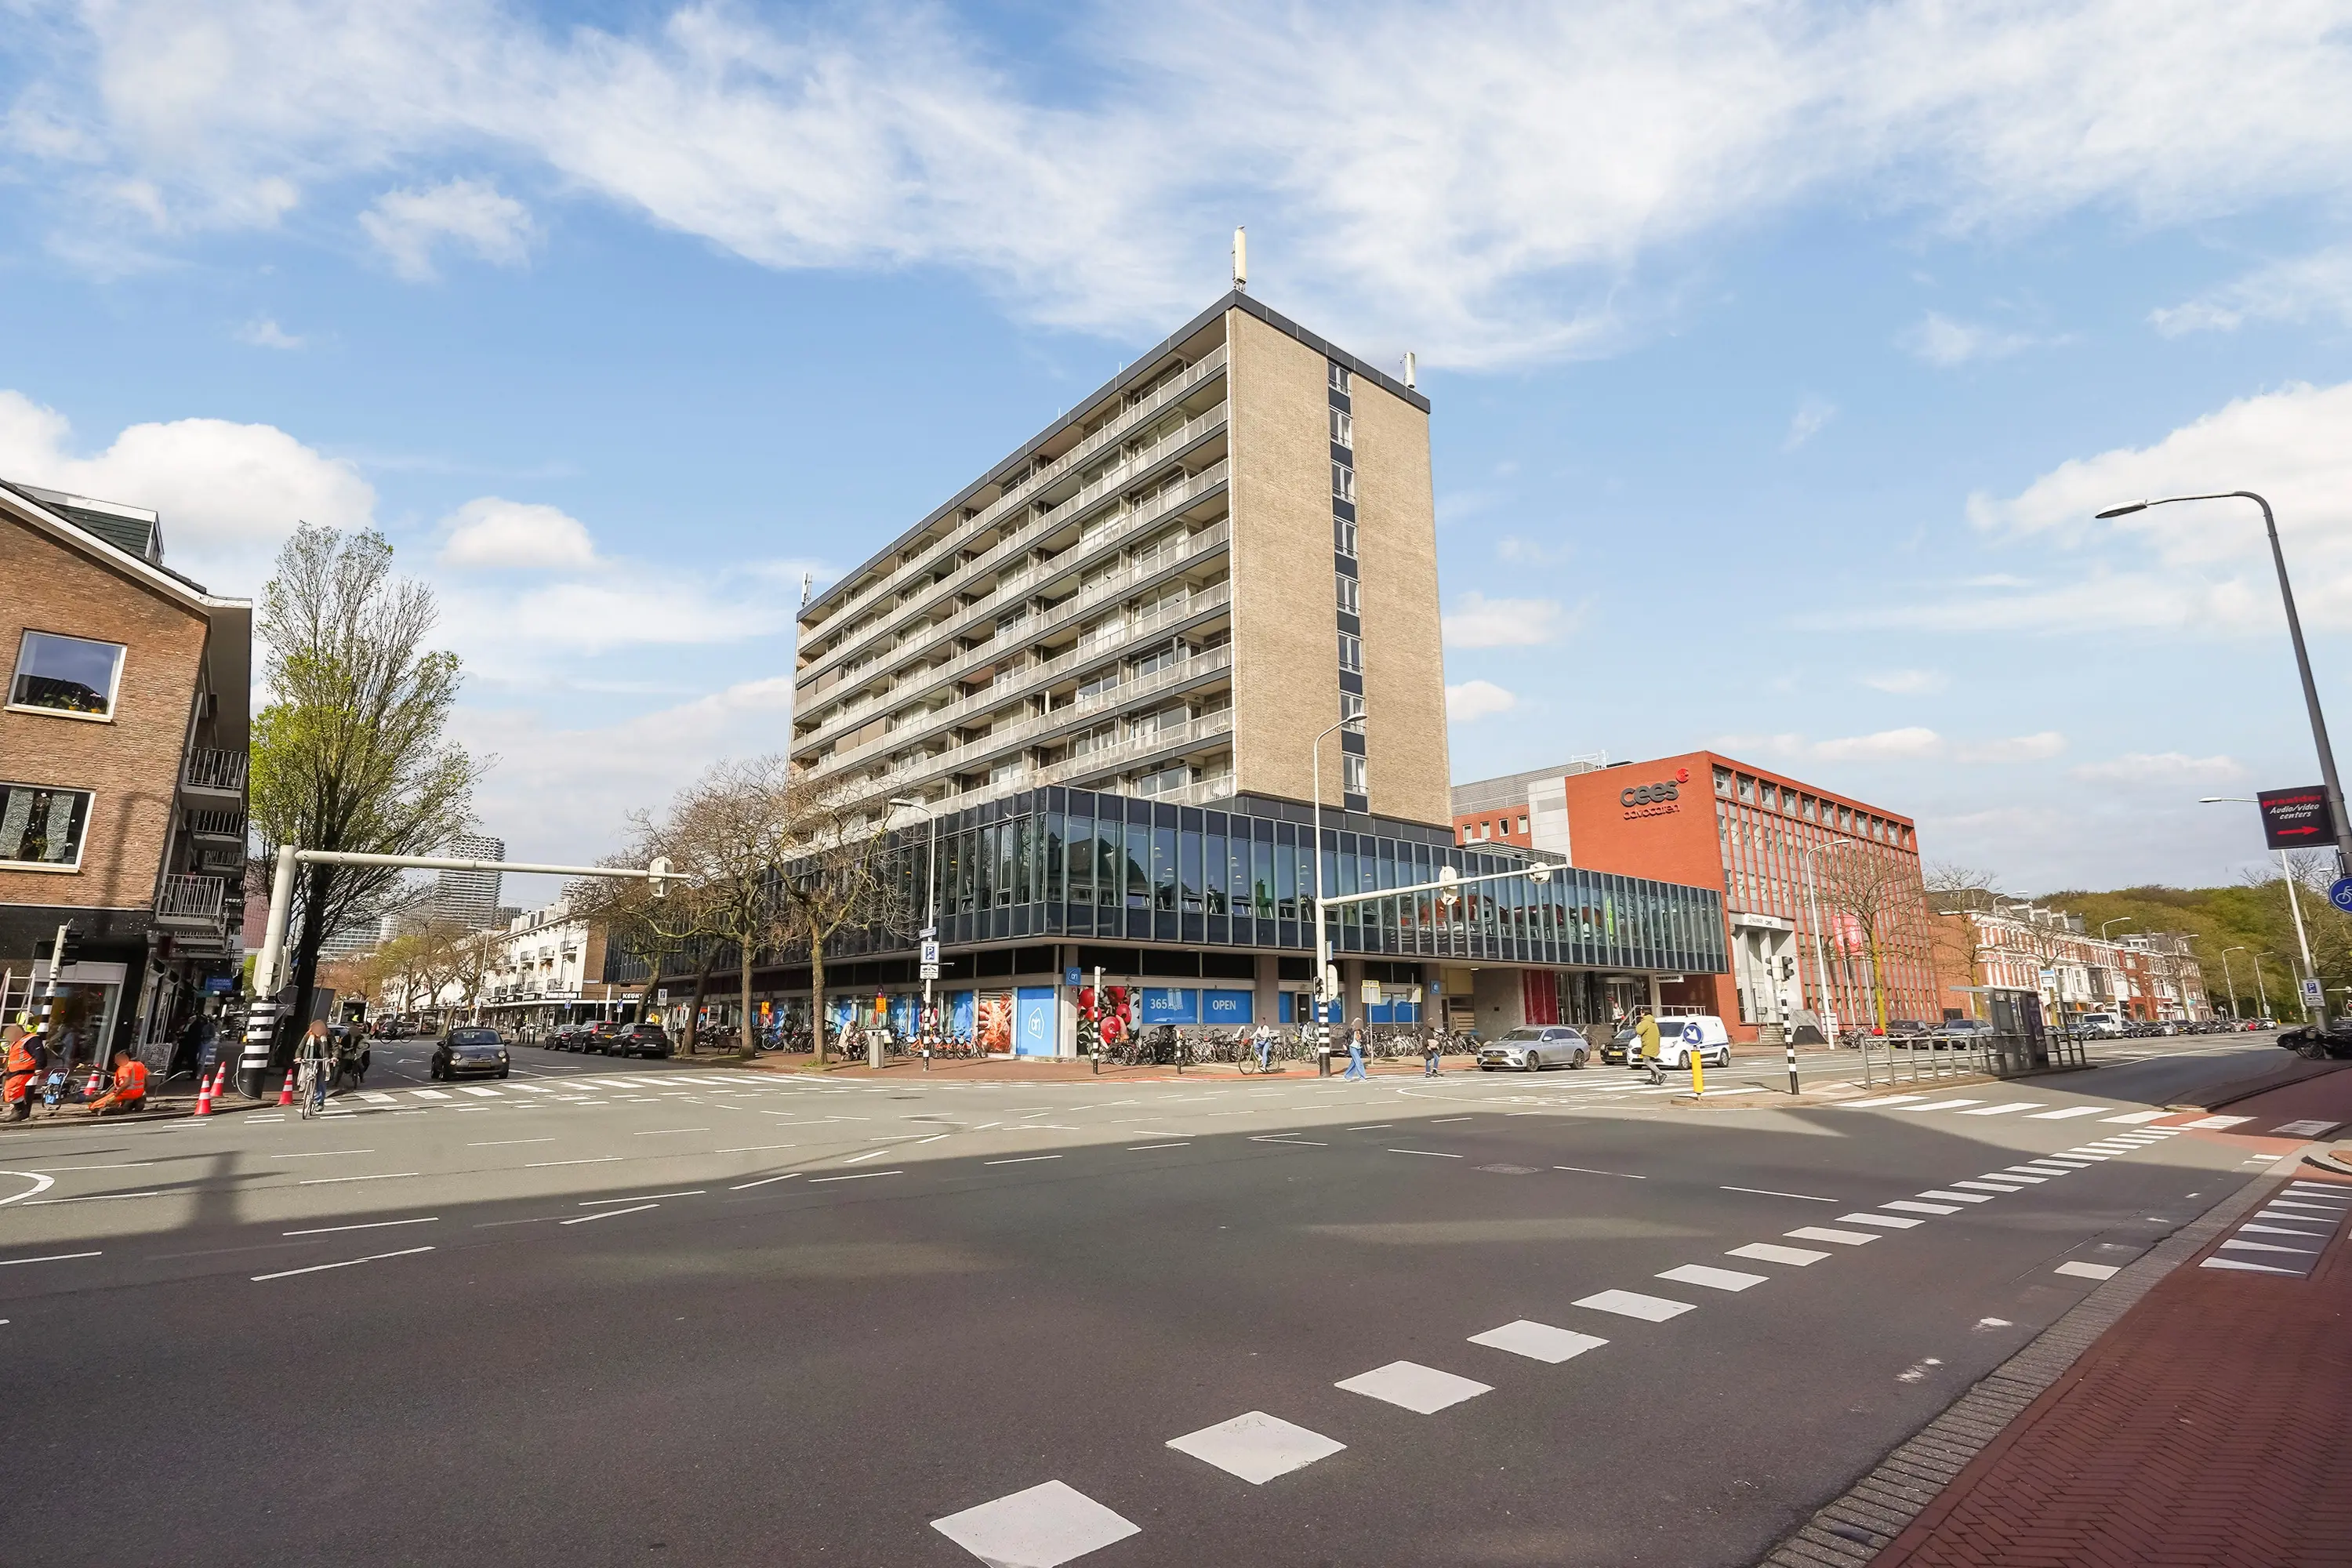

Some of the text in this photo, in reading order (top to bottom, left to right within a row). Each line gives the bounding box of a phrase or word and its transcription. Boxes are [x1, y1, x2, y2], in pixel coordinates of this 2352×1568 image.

[1620, 780, 1679, 808] cees
[2269, 804, 2320, 815] Audio/video
[2279, 811, 2312, 820] centers
[1150, 998, 1167, 1009] 365
[1212, 1000, 1236, 1011] OPEN
